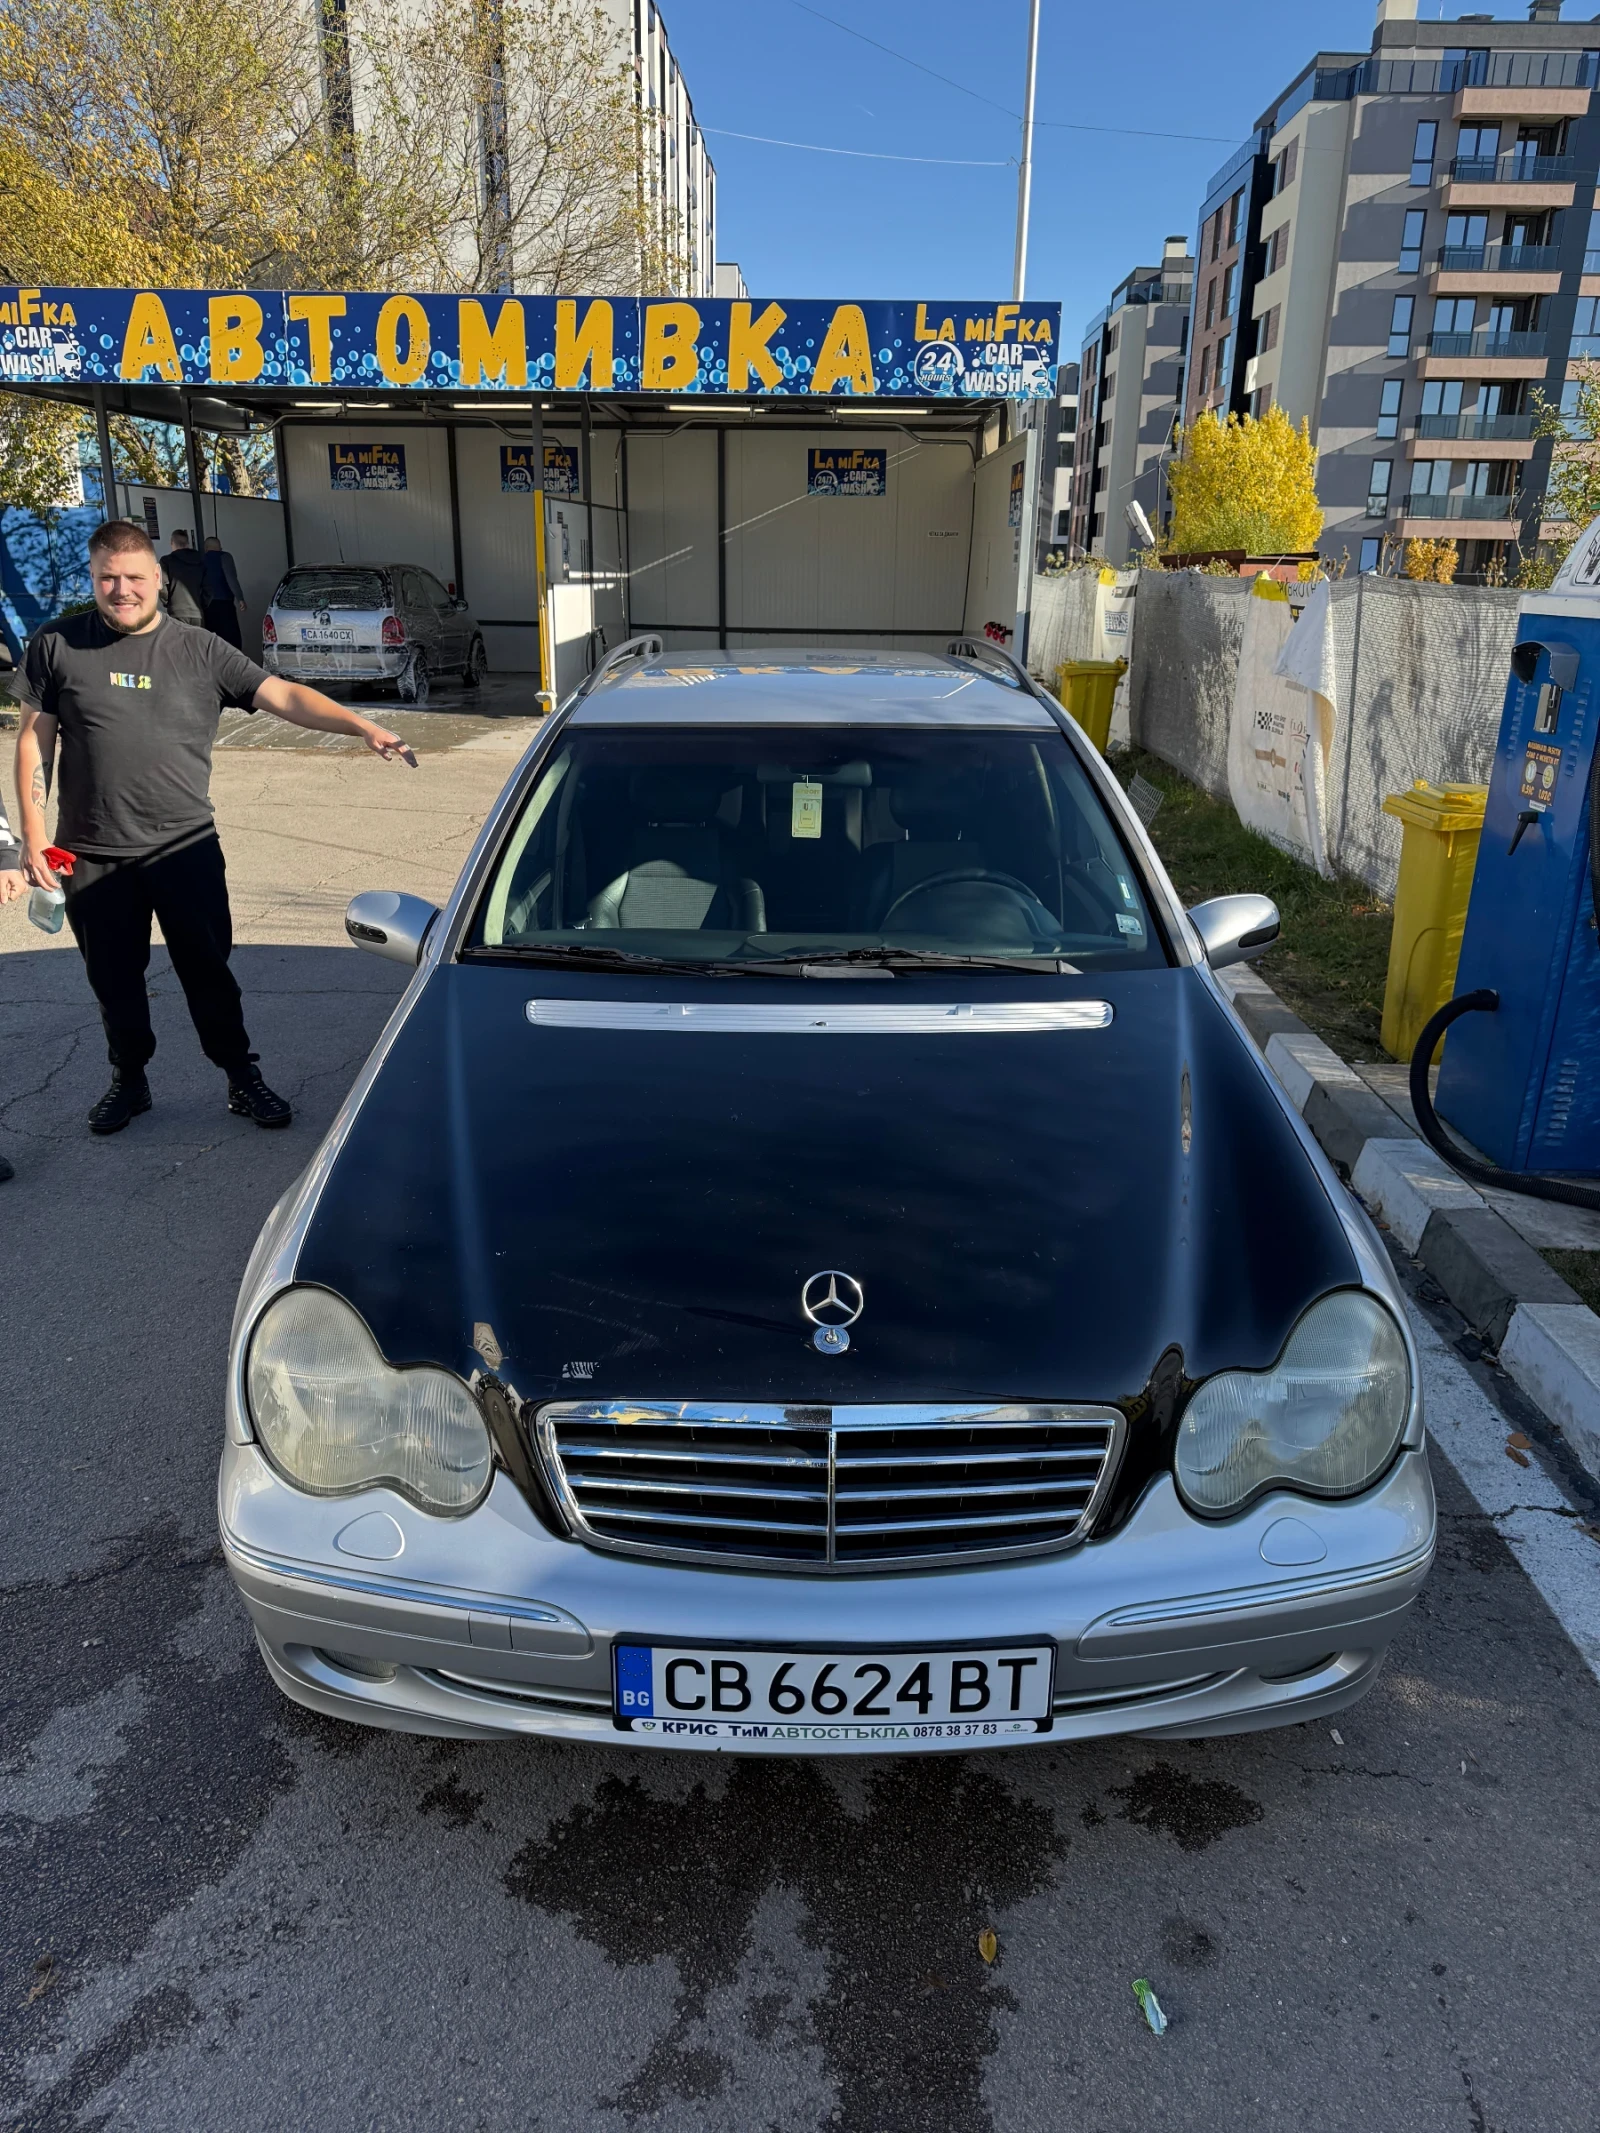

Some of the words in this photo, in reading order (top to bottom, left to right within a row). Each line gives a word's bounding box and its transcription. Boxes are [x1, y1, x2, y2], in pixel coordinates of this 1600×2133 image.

[15, 326, 53, 348] CAR
[119, 292, 875, 394] АВТОМИВКА
[922, 351, 952, 373] 24
[985, 343, 1023, 366] CAR
[1, 354, 57, 376] WASH
[921, 374, 951, 382] HOURS
[964, 371, 1021, 393] WASH
[371, 465, 388, 476] CAR
[849, 470, 867, 481] CAR
[363, 477, 389, 488] WASH
[543, 480, 560, 491] ASH
[840, 483, 867, 494] WASH
[307, 630, 318, 639] CA
[320, 631, 339, 640] 1640
[340, 631, 351, 640] CX
[109, 671, 136, 688] NIKE
[137, 675, 152, 690] SB
[665, 1657, 752, 1713] CB
[768, 1661, 933, 1716] 6624
[949, 1657, 1038, 1713] BT
[623, 1690, 650, 1706] BG
[662, 1721, 718, 1736] КРИС
[728, 1724, 768, 1738] ТиМ
[771, 1727, 910, 1739] АВТОСТЪКЛА
[913, 1725, 942, 1738] 0878
[946, 1725, 961, 1736] 38
[964, 1724, 980, 1736] 37
[982, 1723, 998, 1735] 83
